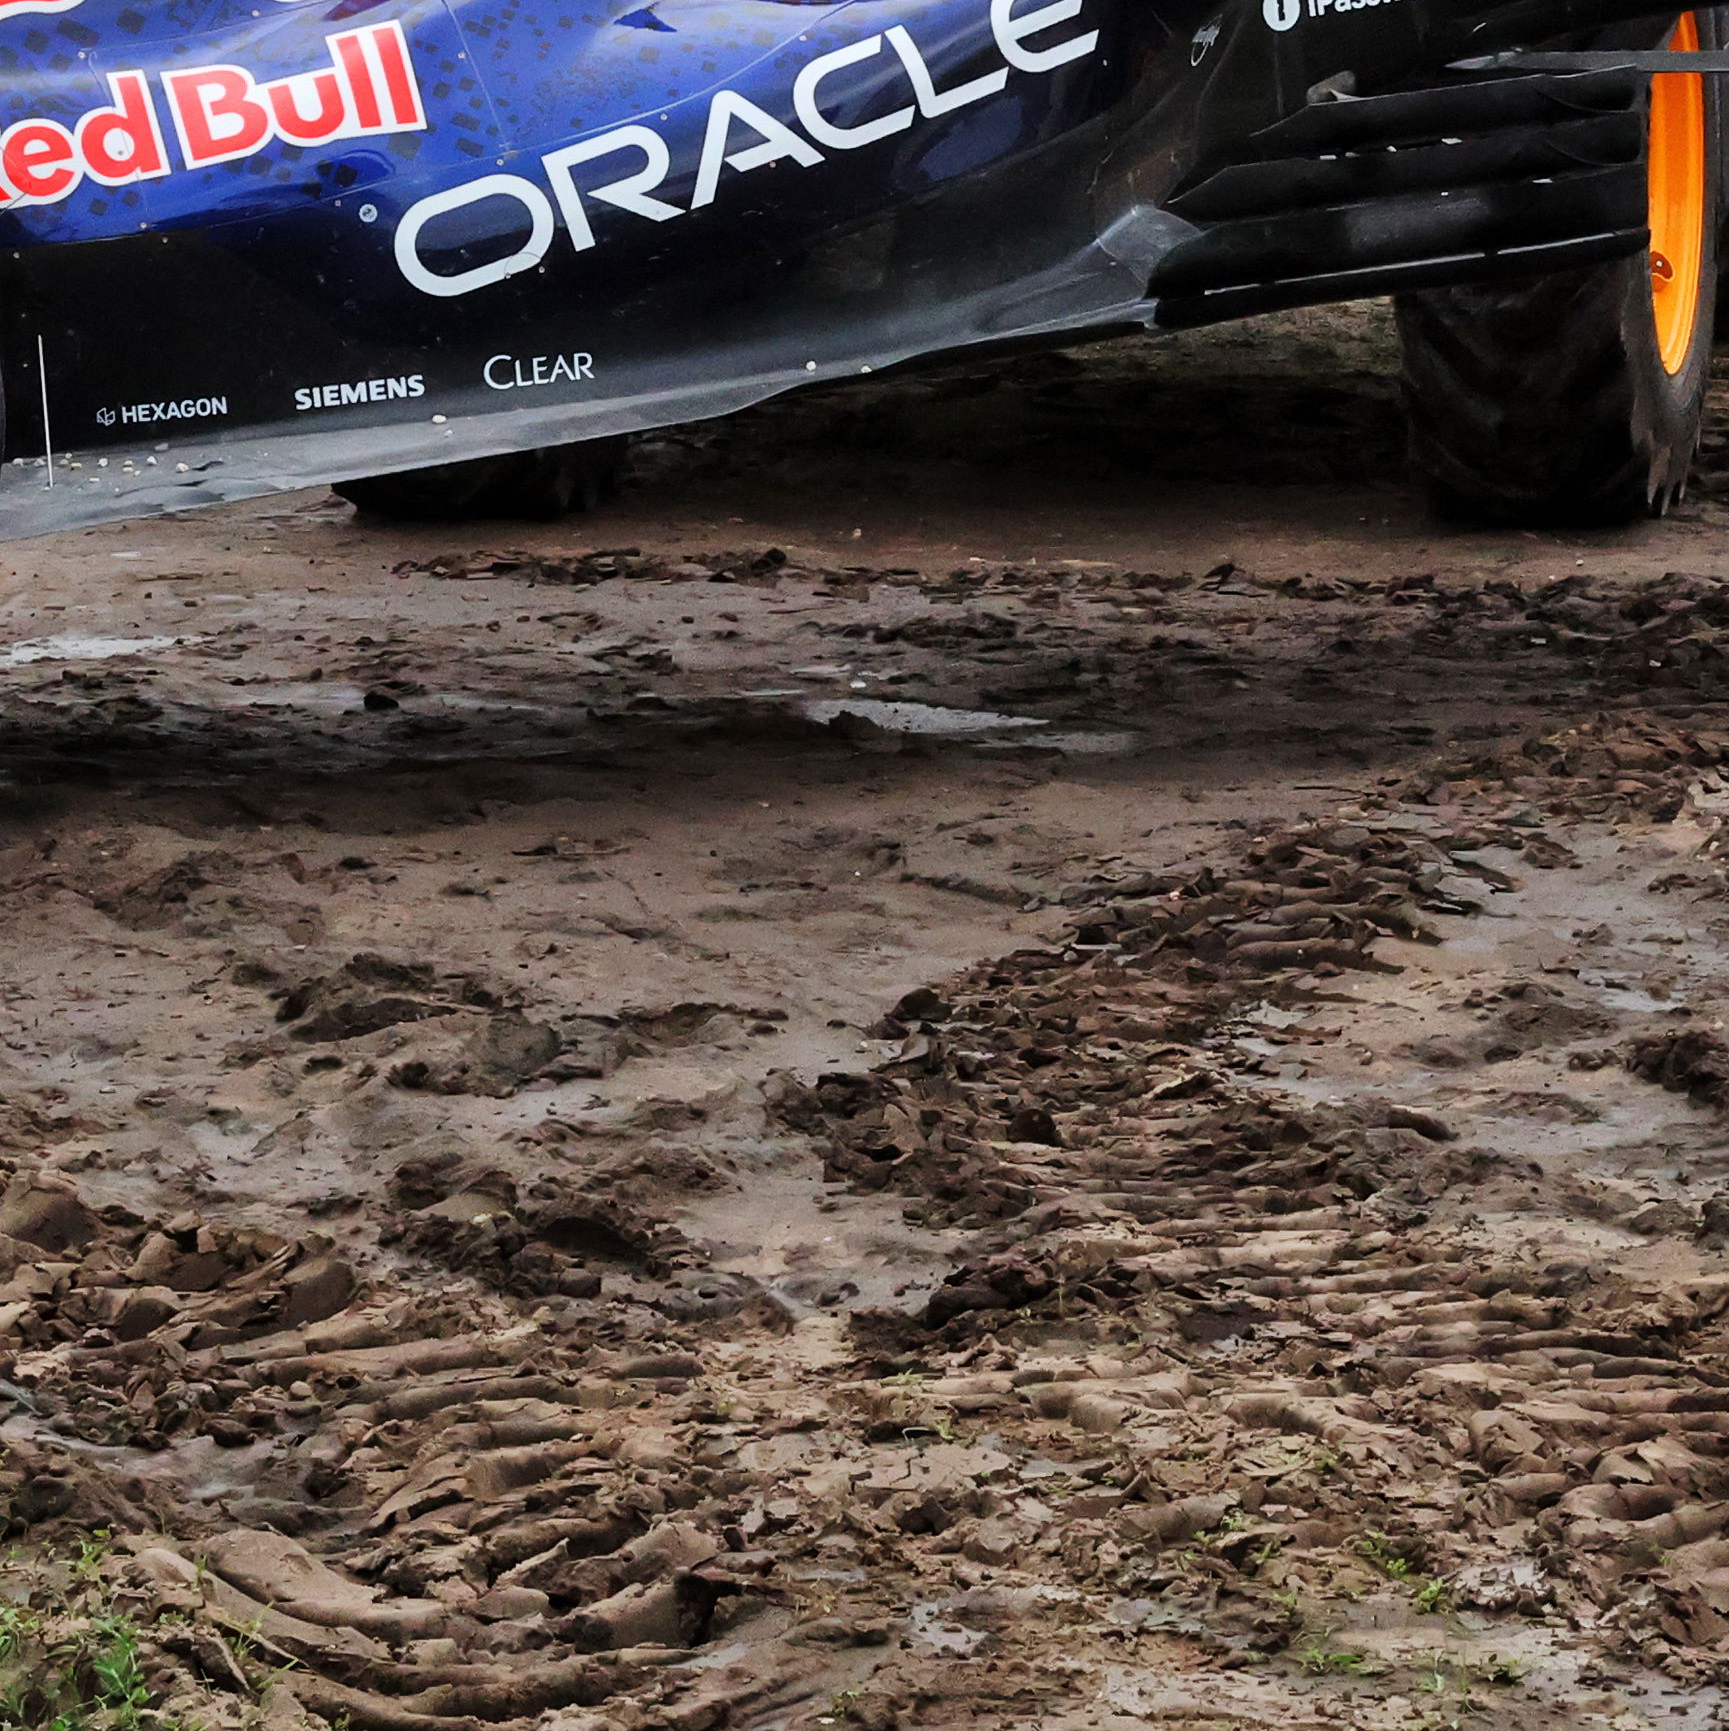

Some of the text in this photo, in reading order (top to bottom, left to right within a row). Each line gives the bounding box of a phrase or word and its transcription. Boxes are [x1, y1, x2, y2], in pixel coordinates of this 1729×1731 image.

[160, 19, 427, 172] Bull
[482, 351, 596, 391] CLEAR
[120, 395, 228, 426] HEXAGON
[294, 374, 427, 412] SIEMENS
